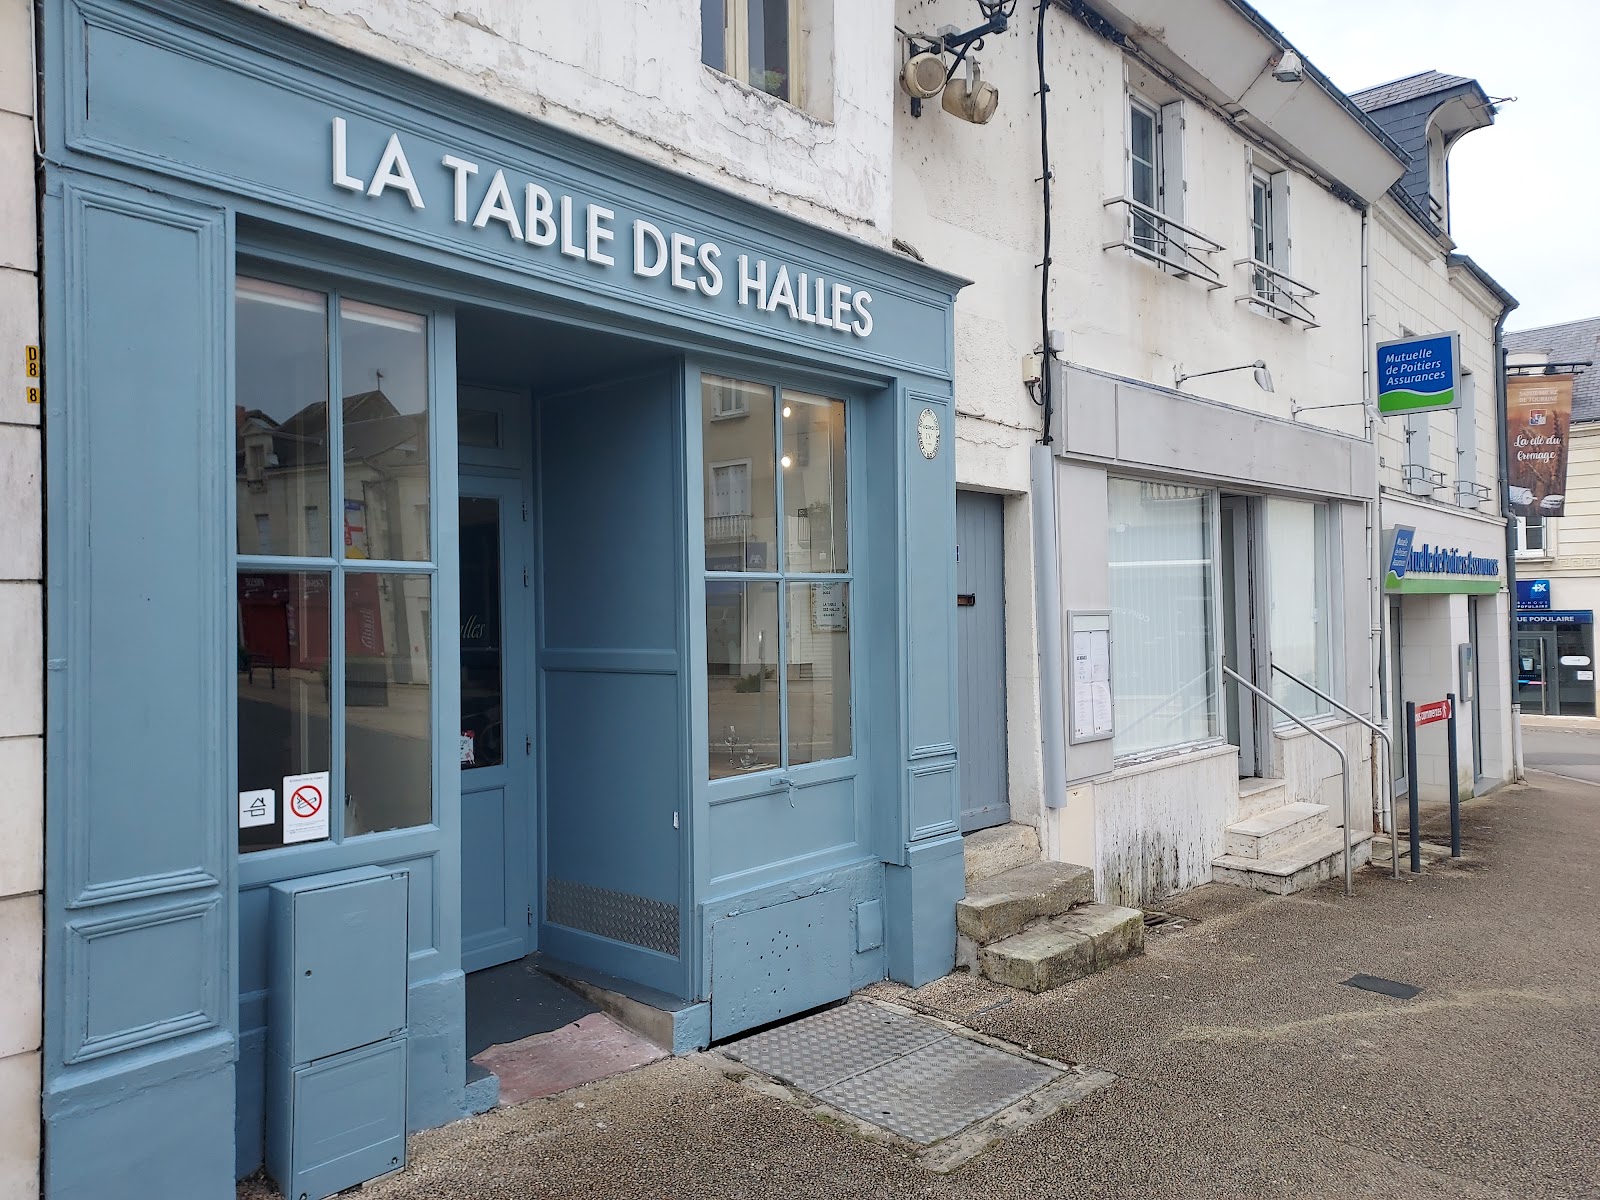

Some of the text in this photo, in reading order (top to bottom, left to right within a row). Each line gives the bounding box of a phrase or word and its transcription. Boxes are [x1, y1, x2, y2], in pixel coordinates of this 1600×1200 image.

[332, 116, 873, 337] LA TABLE DES HALLES
[1385, 348, 1432, 363] Mutuelle
[1386, 360, 1441, 375] de Poitiers
[1386, 370, 1446, 386] Assurances
[30, 388, 37, 402] 8
[1514, 434, 1529, 448] La
[1546, 435, 1561, 445] du
